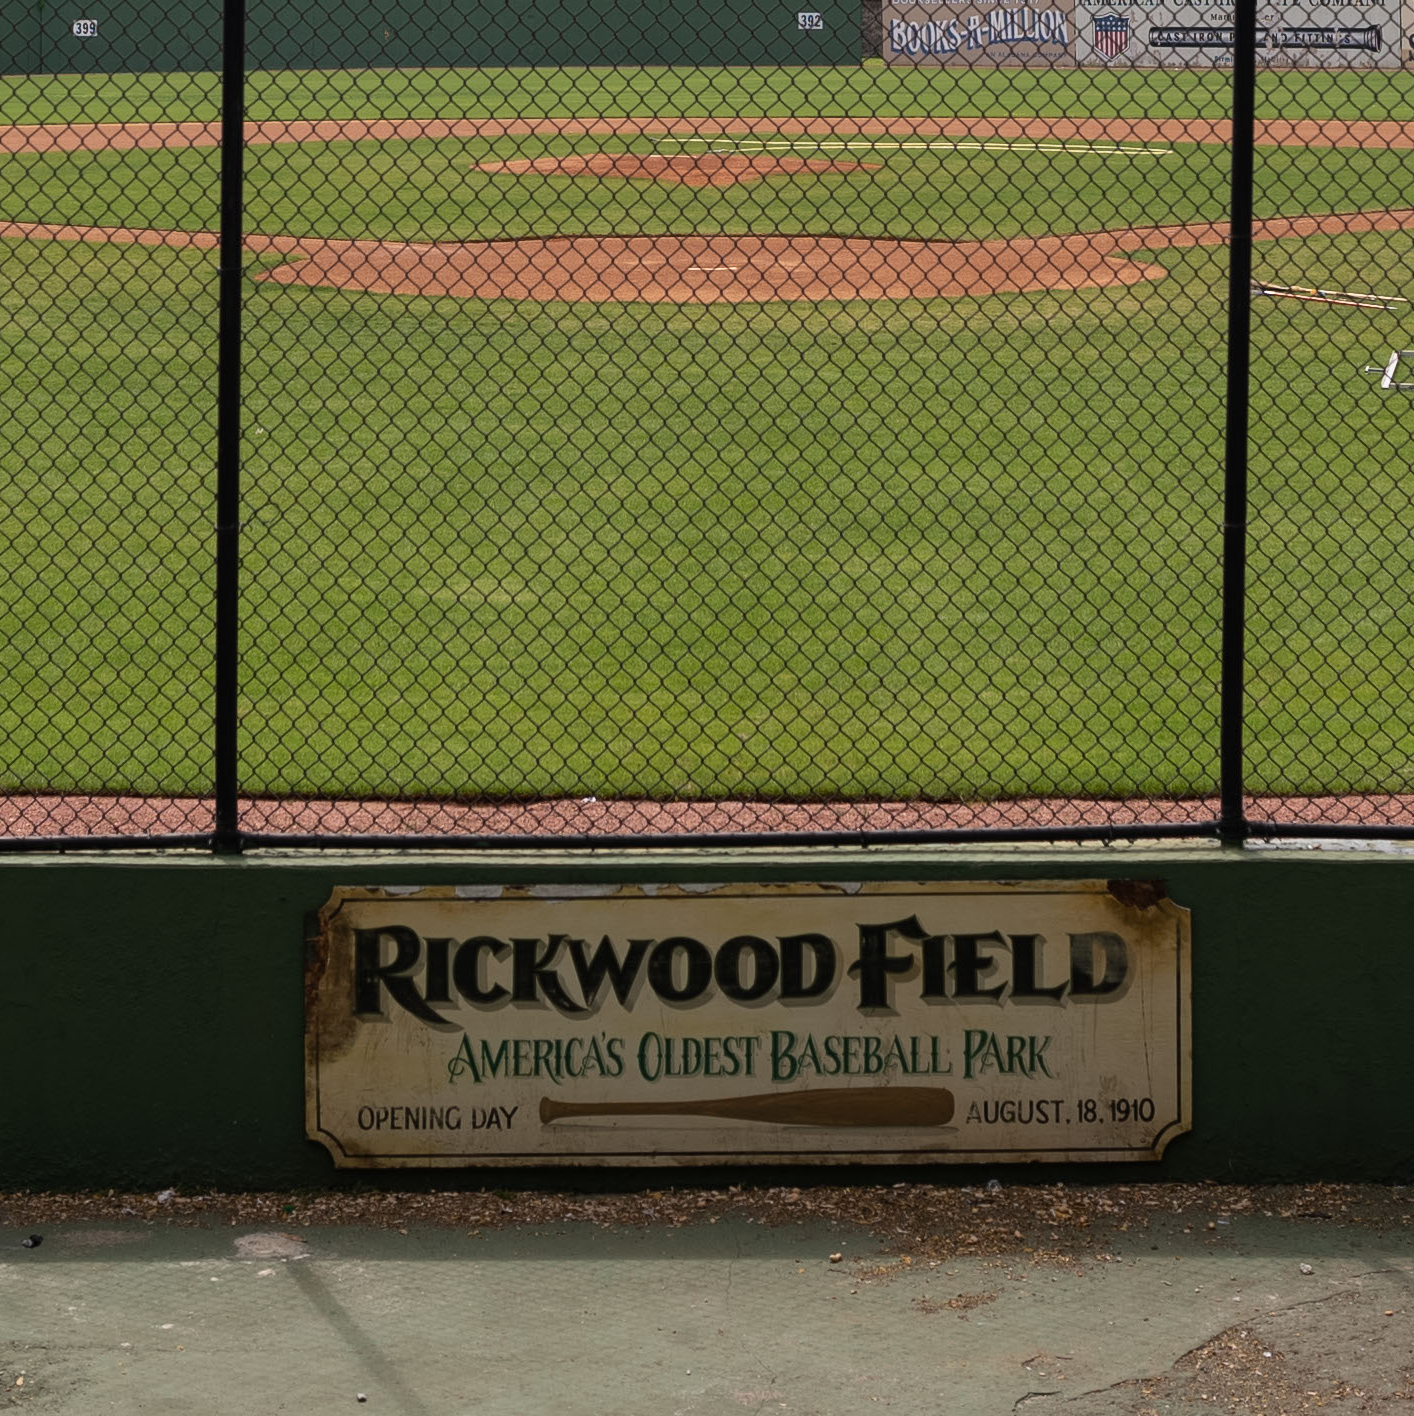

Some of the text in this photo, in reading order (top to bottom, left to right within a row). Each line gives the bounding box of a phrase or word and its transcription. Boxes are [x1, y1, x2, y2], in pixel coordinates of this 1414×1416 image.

[75, 22, 96, 35] 399
[800, 14, 821, 27] 392
[1157, 32, 1187, 42] CAST
[1193, 32, 1223, 42] IRON
[1294, 33, 1352, 43] FITTINS
[351, 913, 1135, 1030] RICKWOOD FIELD
[447, 1027, 1054, 1085] AMERICA'S OLDEST BASEBALL PARK
[357, 1104, 462, 1132] OPENING
[471, 1104, 519, 1131] DAY
[1109, 1096, 1156, 1124] 1910
